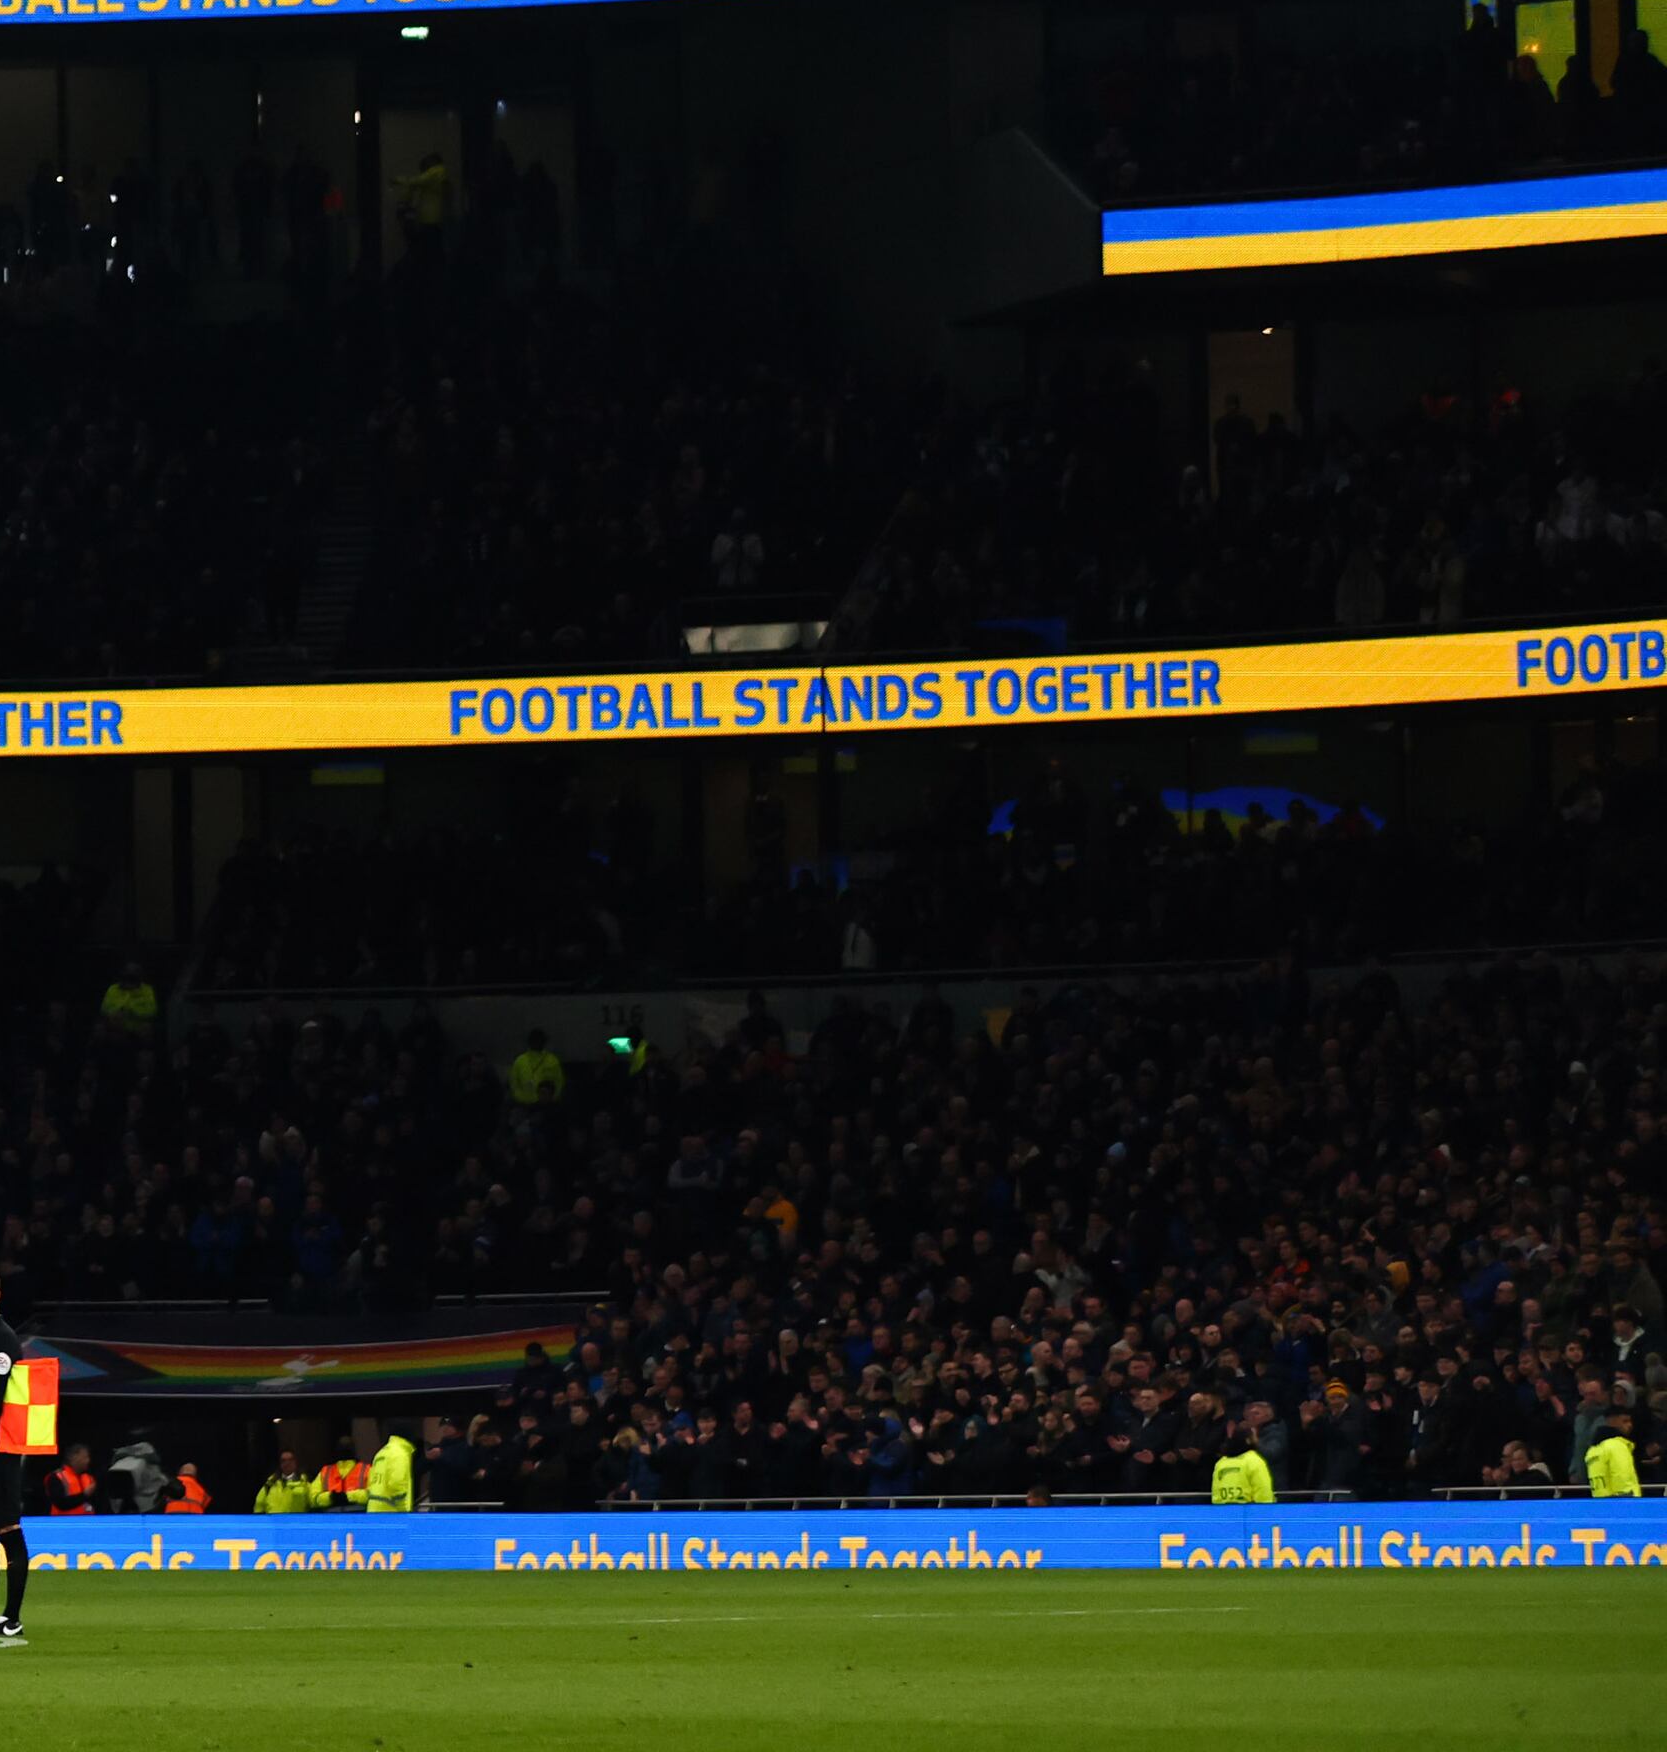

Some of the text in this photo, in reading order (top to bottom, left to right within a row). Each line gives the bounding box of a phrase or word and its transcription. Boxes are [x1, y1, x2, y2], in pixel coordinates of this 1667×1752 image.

[1518, 631, 1667, 686] FOOTB
[452, 661, 1220, 734] FOOTBALL STANDS TOGETHER
